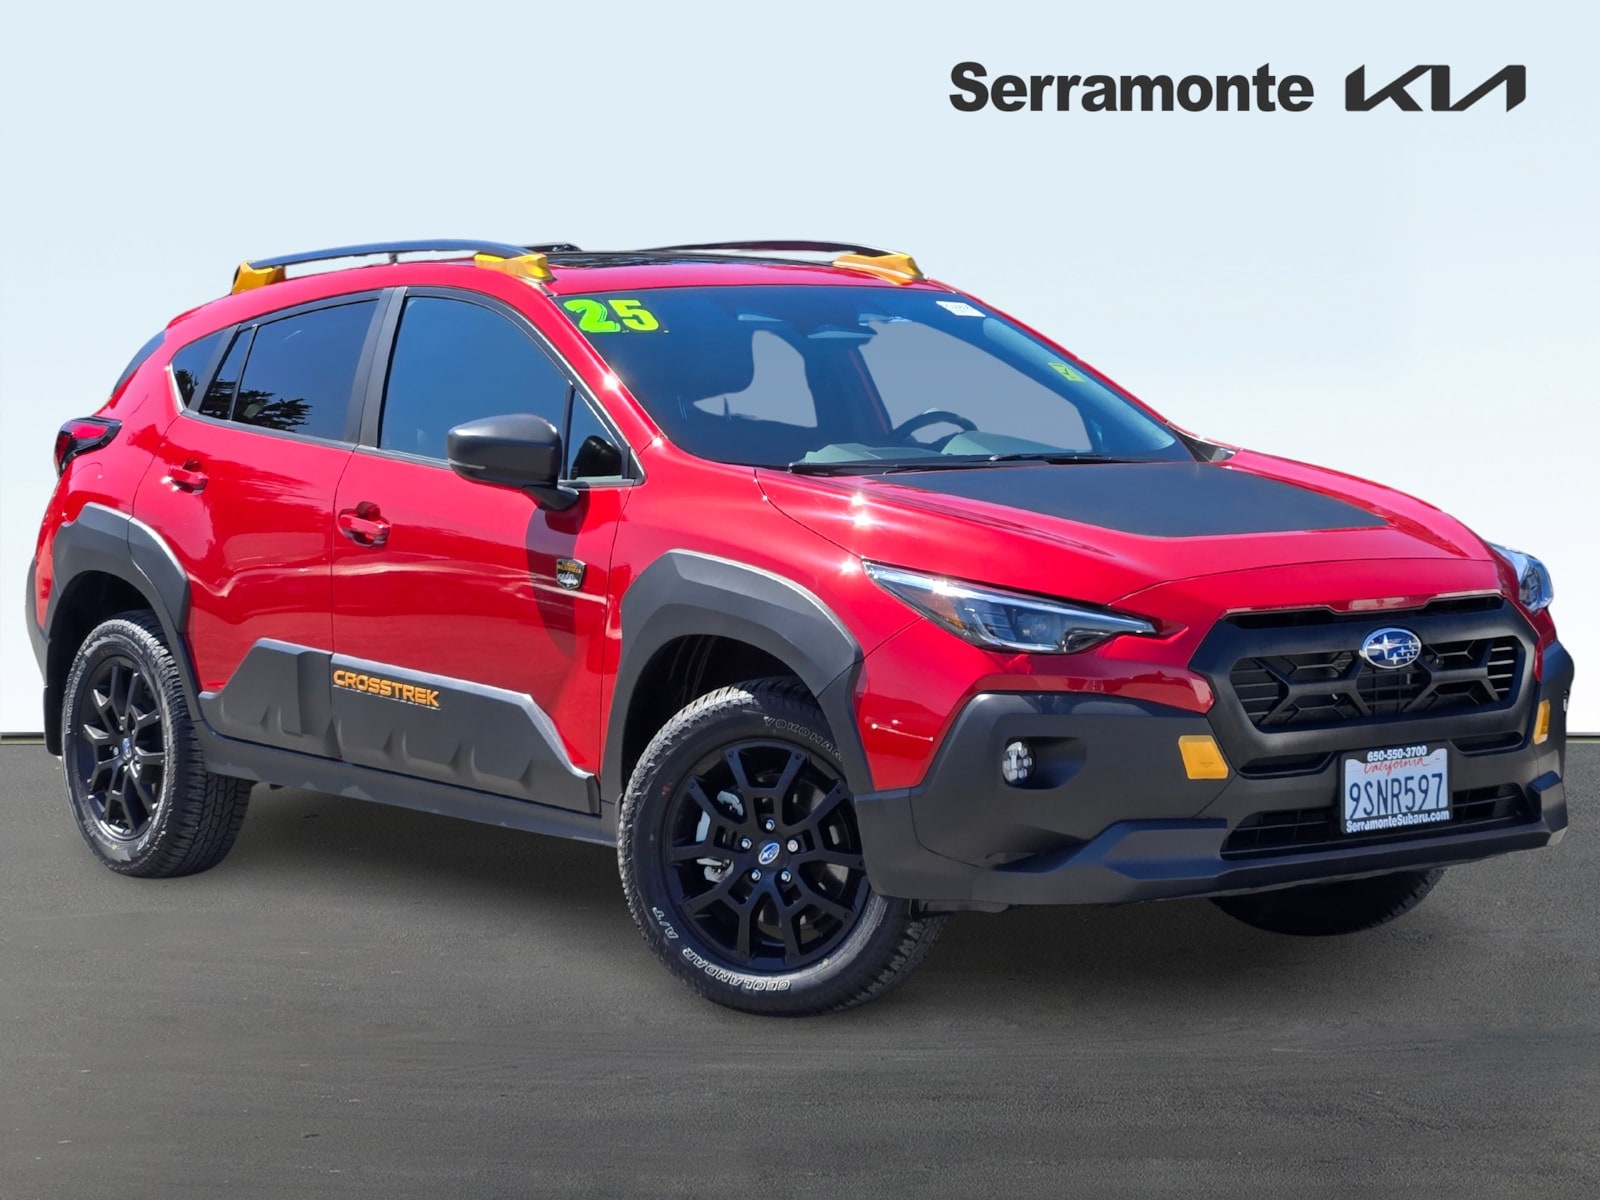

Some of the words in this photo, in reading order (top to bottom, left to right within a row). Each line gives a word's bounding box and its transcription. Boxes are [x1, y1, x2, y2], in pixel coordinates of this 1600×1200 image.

[563, 299, 659, 333] 25
[333, 670, 439, 707] CROSSTREK
[1367, 745, 1427, 762] 650-550-3700
[1349, 773, 1443, 819] 9SNR597
[1346, 810, 1450, 833] SerramonteSubaru.com
[682, 947, 791, 991] GEOLANDAR
